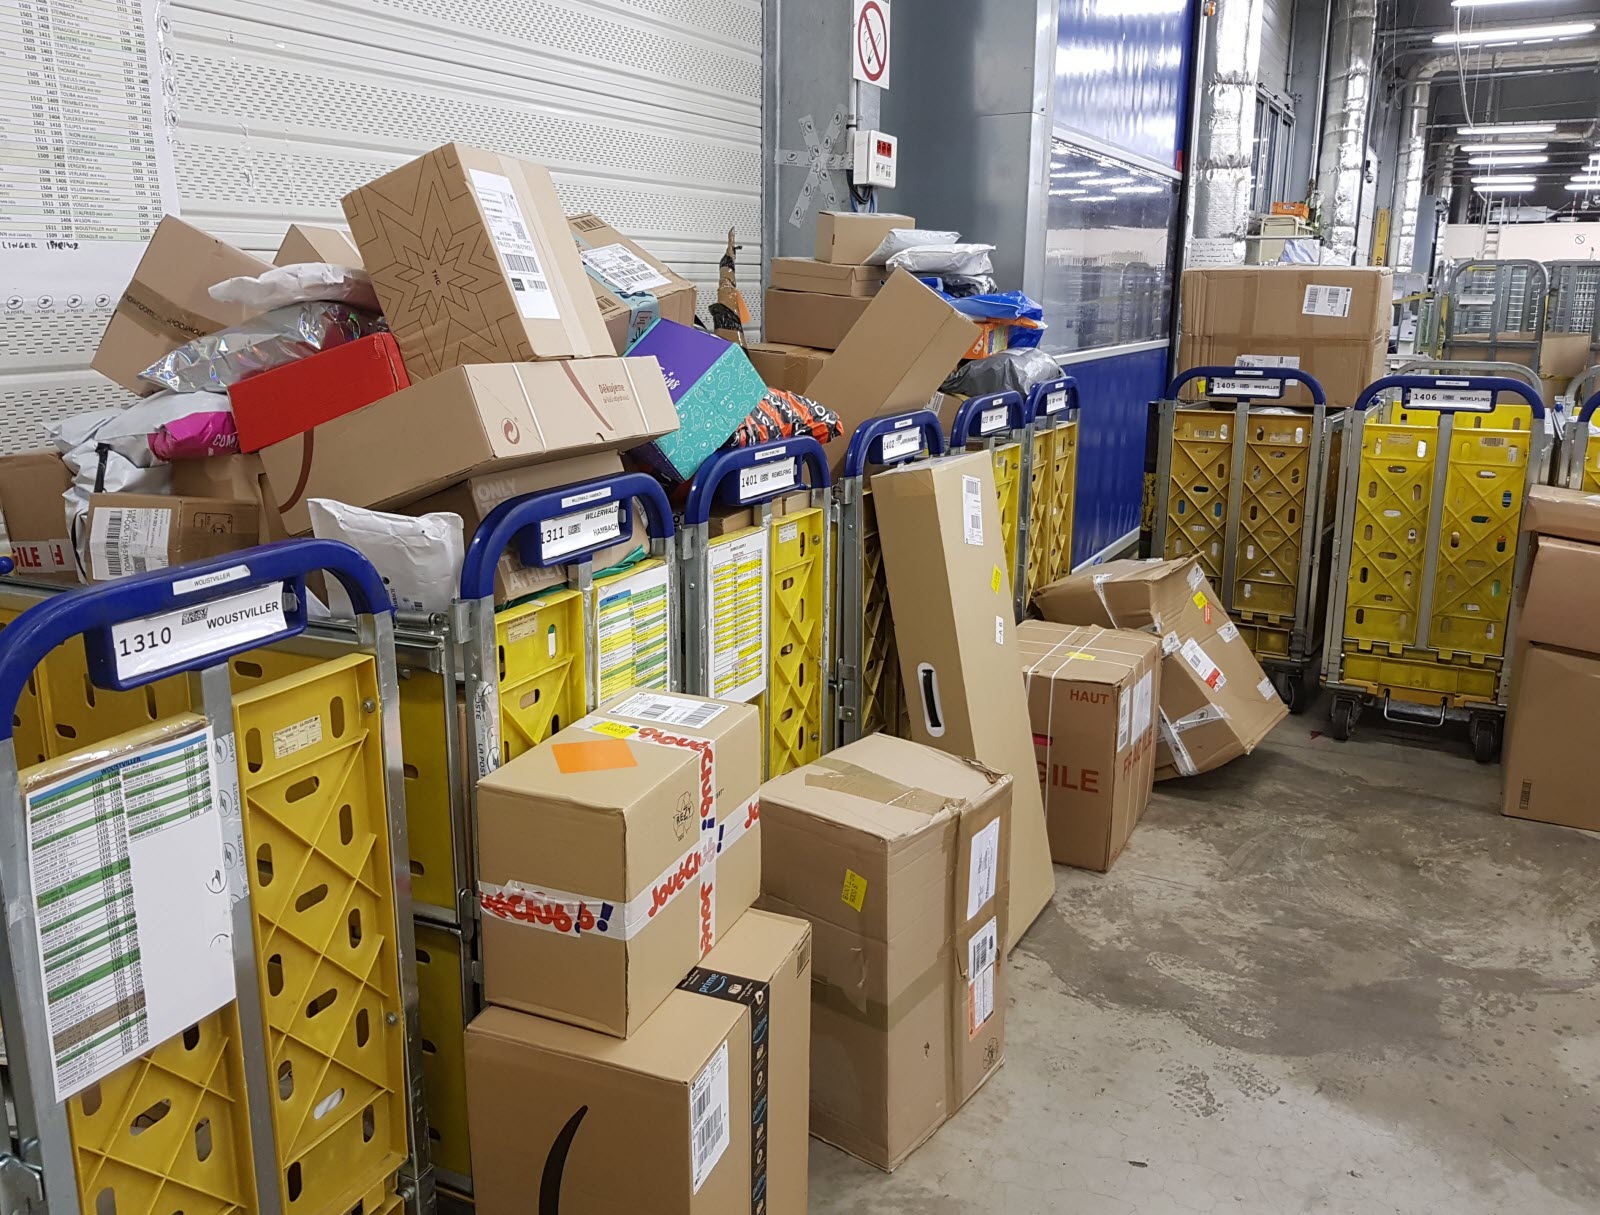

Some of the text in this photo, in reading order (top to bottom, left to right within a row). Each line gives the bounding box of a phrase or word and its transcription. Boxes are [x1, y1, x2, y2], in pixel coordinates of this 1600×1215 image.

[742, 468, 791, 488] 1401 REMELFING
[477, 478, 518, 499] ONLY
[585, 506, 618, 520] WILLERWALD
[541, 527, 564, 544] 1311
[592, 523, 618, 536] HAMBACH
[194, 572, 231, 587] WOUSTVILLER
[119, 601, 279, 657] 1310 WOUSTVILLER
[1070, 689, 1109, 705] HAUT
[699, 973, 719, 993] prime
